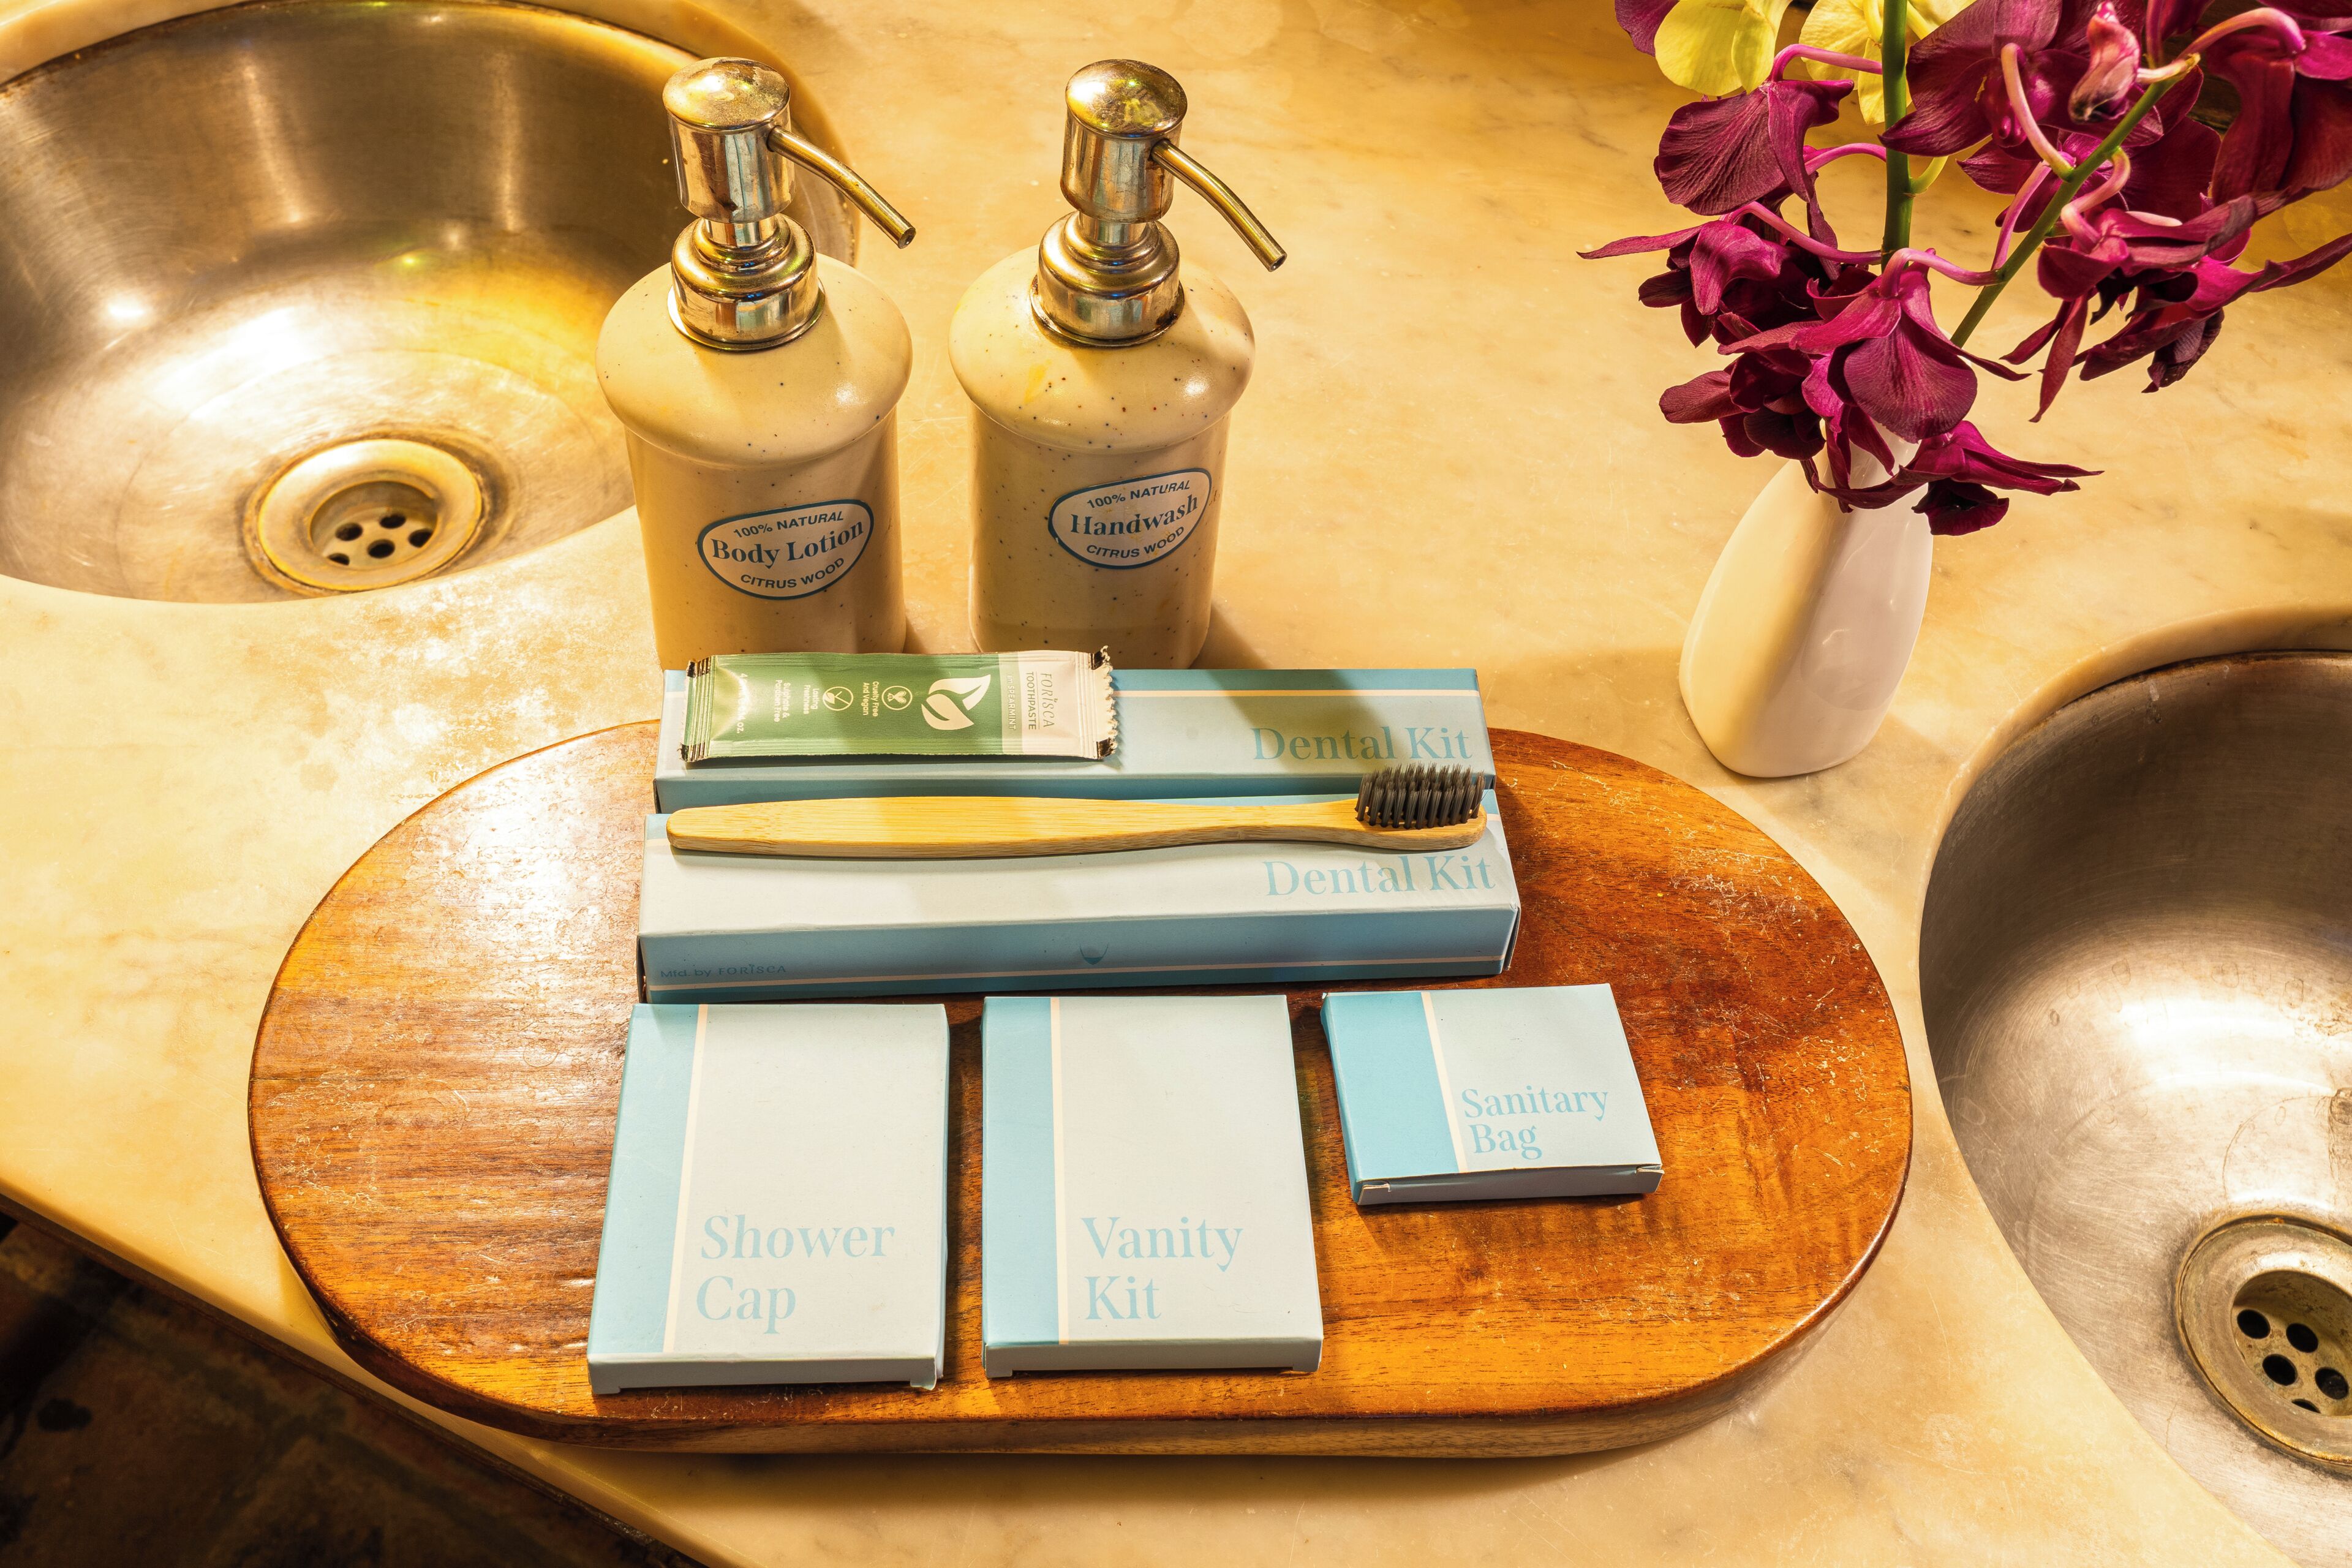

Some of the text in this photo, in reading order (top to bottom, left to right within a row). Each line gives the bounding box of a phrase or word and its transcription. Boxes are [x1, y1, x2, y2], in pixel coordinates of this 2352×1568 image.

[1087, 480, 1190, 508] 100% NATURAL
[733, 511, 844, 538] 100% NATURAL
[1070, 494, 1198, 535] Handwash
[710, 521, 864, 570] Body Lotion
[1086, 526, 1184, 559] CITRUS WOOD
[741, 557, 845, 589] CITRUS WOOD
[774, 679, 782, 706] Paraben
[782, 682, 791, 711] Sulphate
[810, 688, 820, 709] Lasting
[861, 694, 870, 715] Vegan
[871, 681, 880, 701] Cruelty
[1008, 685, 1016, 731] SPEARMINT
[1026, 671, 1036, 730] TOOTHPASTE
[1250, 726, 1473, 761] Dental Kit
[1262, 854, 1496, 896] Dental Kit
[660, 969, 691, 978] Mfd.
[694, 969, 712, 978] by
[1461, 1085, 1609, 1121] Sanitary
[1468, 1123, 1543, 1160] Bag
[701, 1214, 895, 1259] Shower
[1080, 1216, 1244, 1272] Vanity
[696, 1275, 796, 1334] Cap
[1084, 1276, 1162, 1320] Kit
